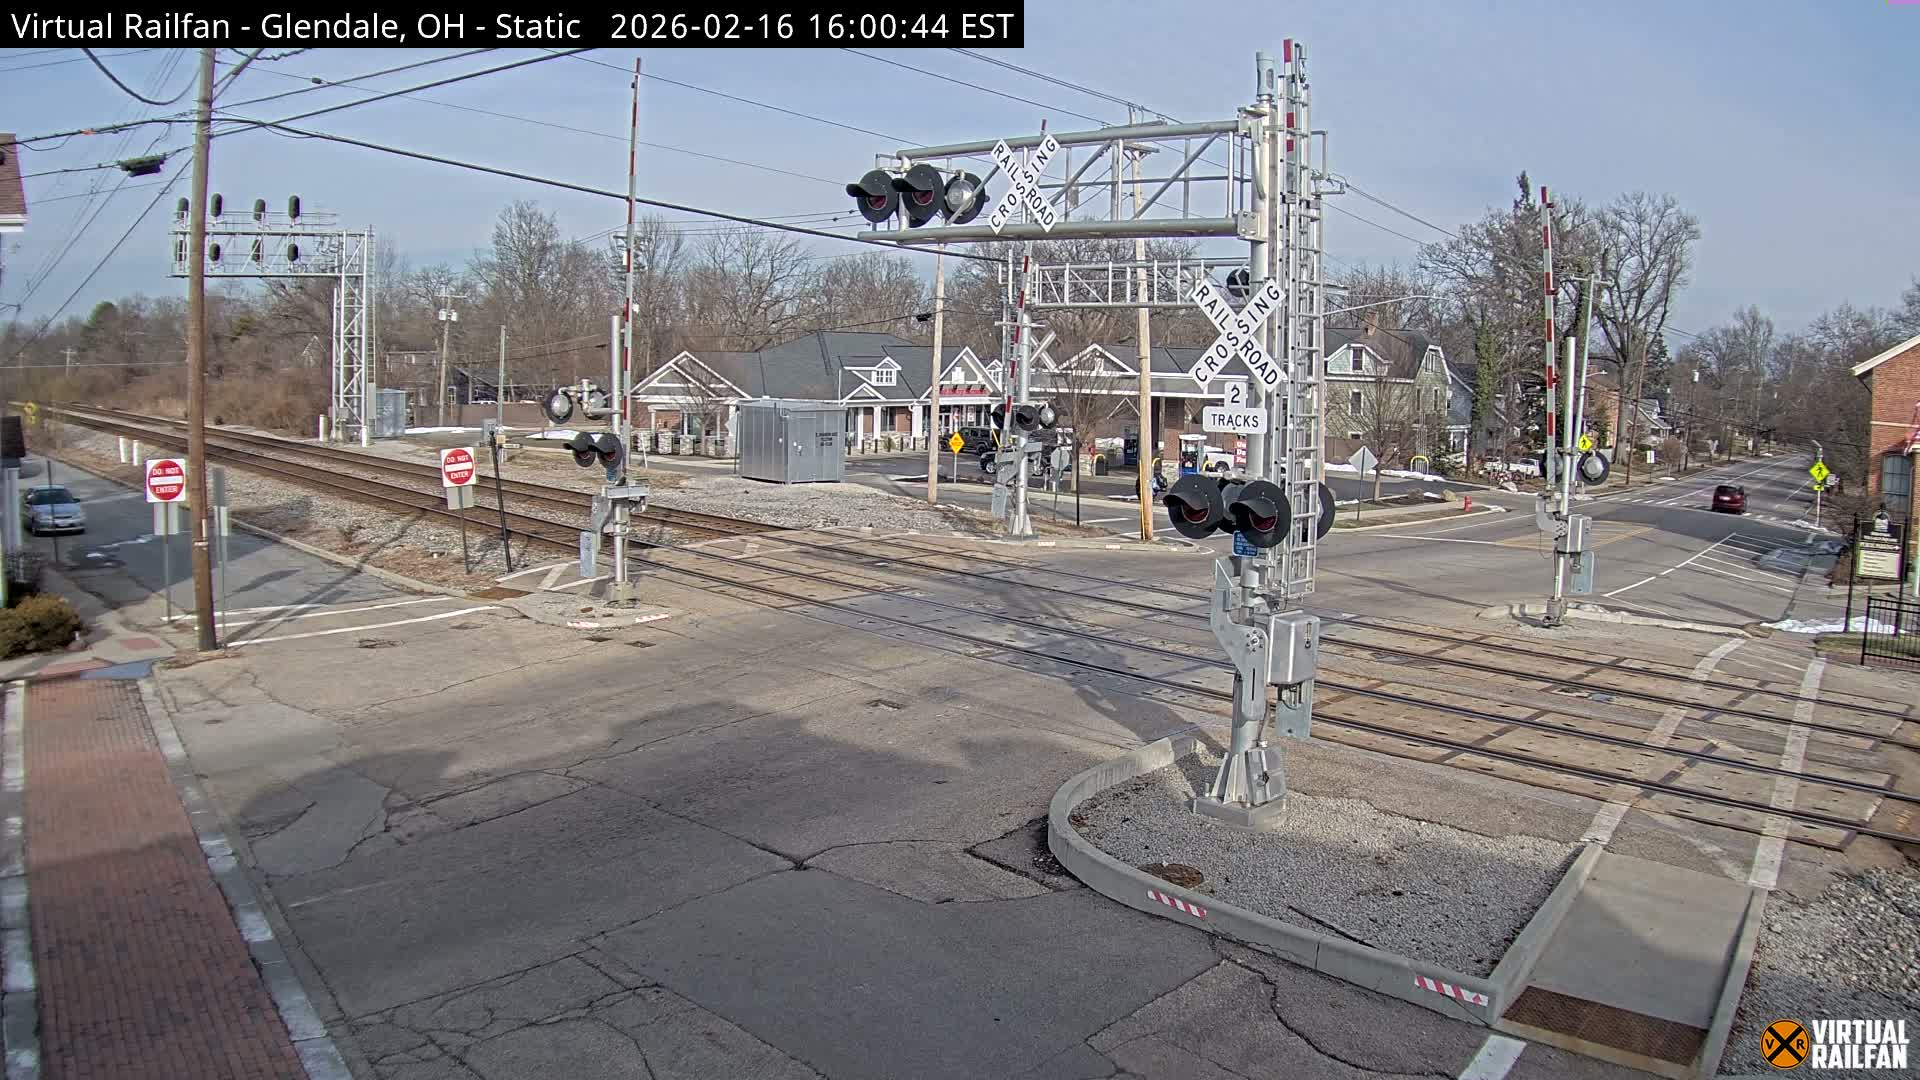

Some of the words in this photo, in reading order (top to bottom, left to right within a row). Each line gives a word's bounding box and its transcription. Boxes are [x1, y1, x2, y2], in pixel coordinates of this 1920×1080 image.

[1230, 387, 1240, 404] 2
[1211, 413, 1259, 428] TRACKS
[457, 454, 469, 462] NOT
[152, 468, 162, 476] DO
[165, 466, 179, 475] NOT
[450, 471, 469, 479] ENTER
[155, 485, 178, 494] ENTER
